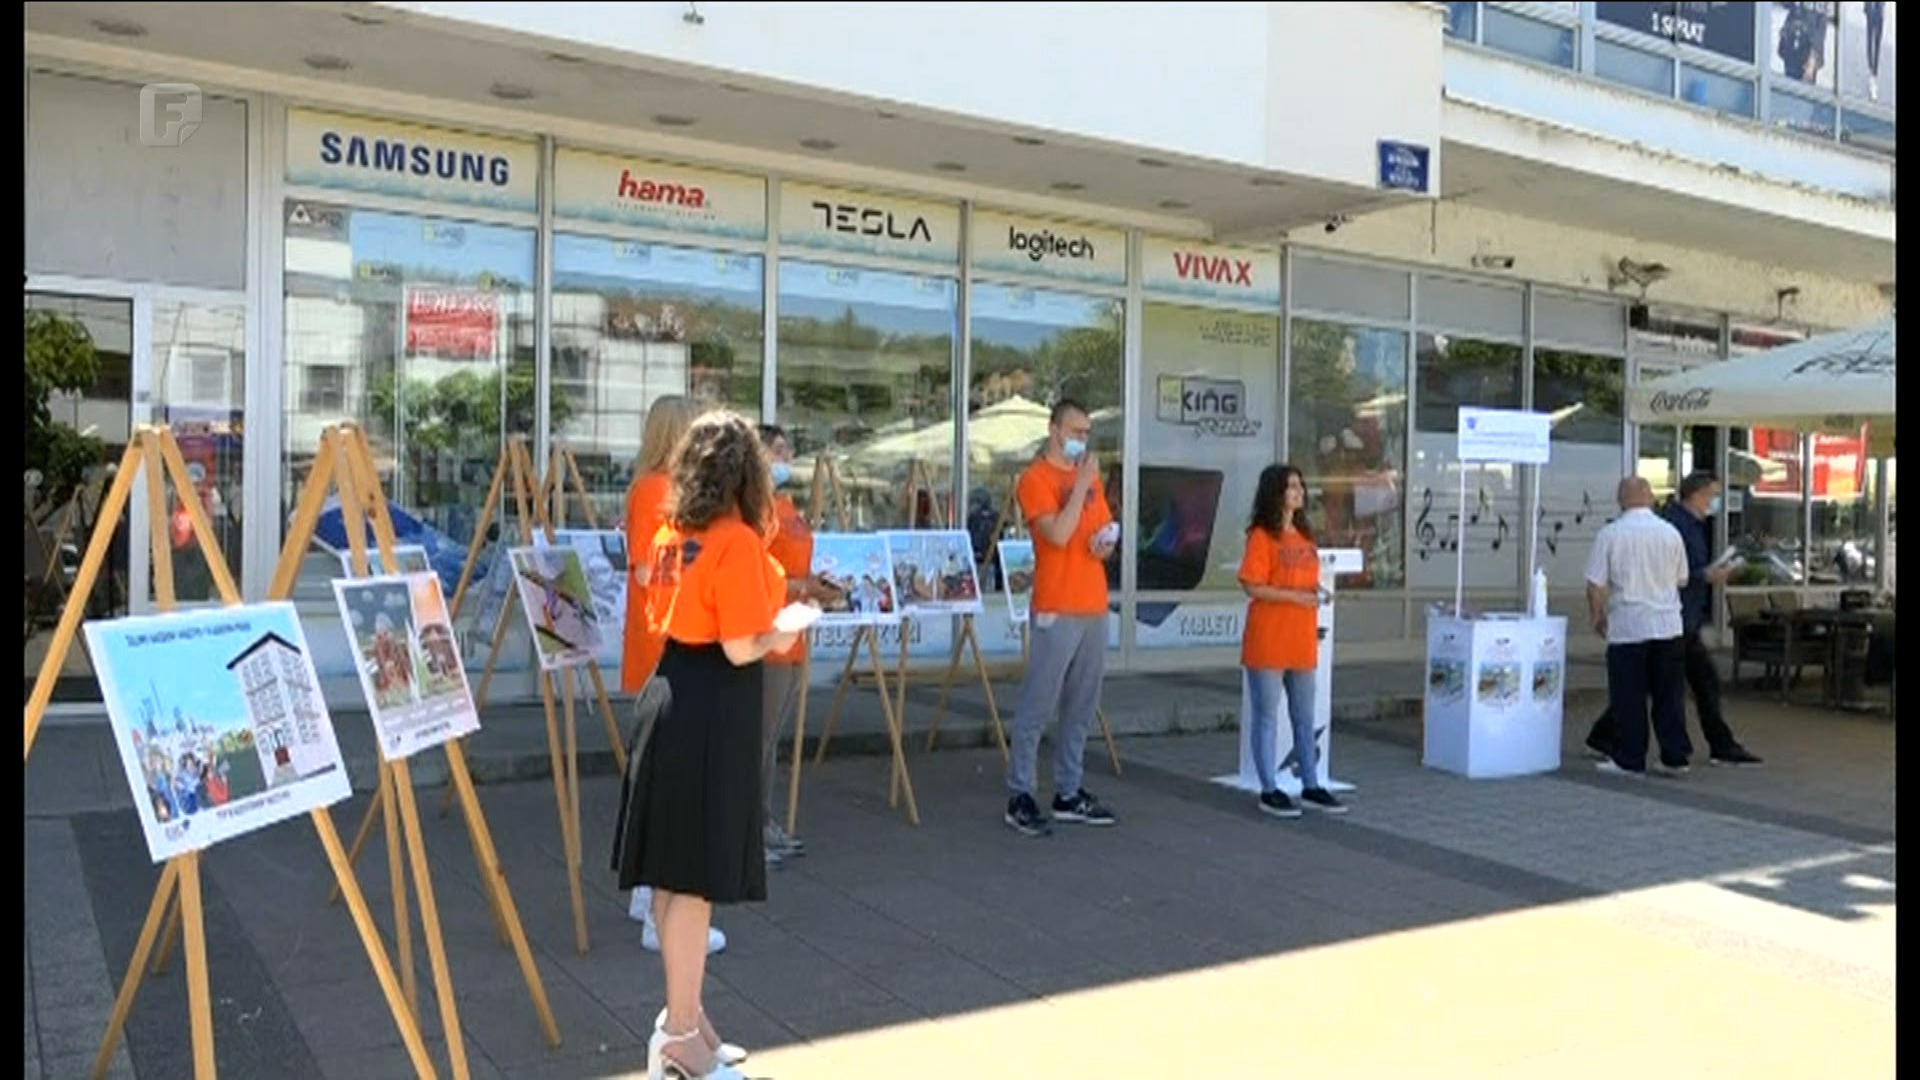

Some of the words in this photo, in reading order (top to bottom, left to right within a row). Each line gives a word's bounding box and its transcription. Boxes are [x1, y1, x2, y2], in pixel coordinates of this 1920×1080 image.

[320, 131, 509, 187] SAMSUNG
[617, 169, 705, 208] hama
[812, 201, 932, 242] TESLA
[1009, 225, 1095, 262] logitech
[1173, 251, 1252, 288] VIVAX
